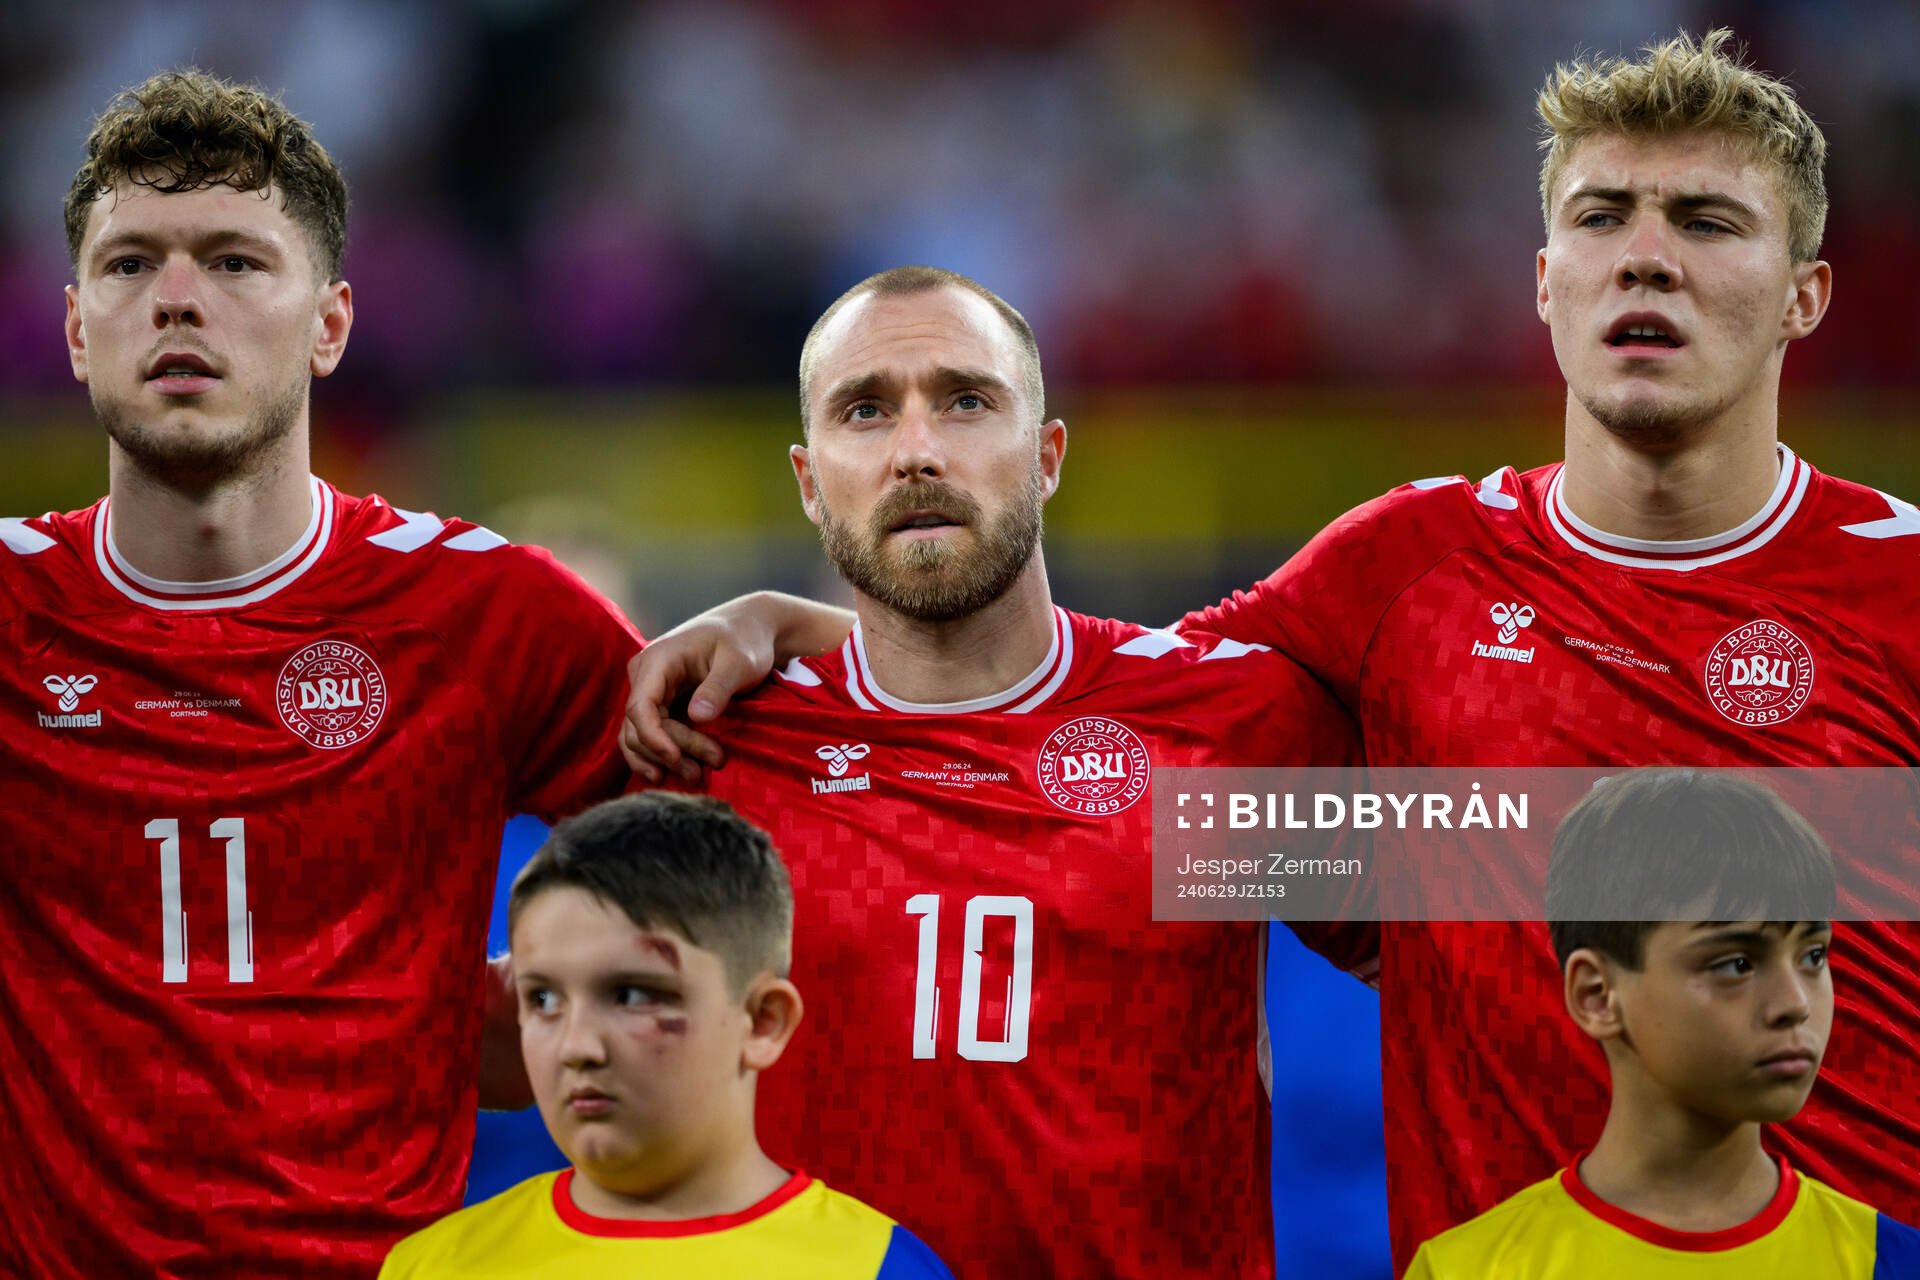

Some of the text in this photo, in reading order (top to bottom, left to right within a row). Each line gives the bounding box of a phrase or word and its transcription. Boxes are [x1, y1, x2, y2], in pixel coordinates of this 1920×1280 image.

[1471, 640, 1535, 664] hummel
[1564, 636, 1609, 653] GERMANY
[1624, 656, 1671, 674] DENMARK
[1596, 653, 1634, 668] DORTMUND
[1709, 649, 1732, 711] DANSK
[1727, 655, 1791, 688] DBU
[135, 698, 242, 710] GERMANY vs DENMARK
[280, 674, 310, 734] DANSK
[298, 677, 363, 710] DBU
[37, 709, 102, 728] hummel
[170, 710, 208, 718] DORTMUND
[1736, 709, 1779, 723] 1889
[314, 730, 358, 746] 1889
[901, 770, 949, 780] GERMANY
[964, 772, 1010, 782] DENMARK
[942, 762, 971, 770] 29.06.24
[1041, 749, 1071, 805] DANSK
[1061, 752, 1127, 782] DBU
[811, 772, 871, 795] hummel
[936, 781, 974, 789] DORTMUND
[1075, 799, 1120, 813] 1889
[144, 817, 254, 983] 11
[905, 894, 1034, 1062] 10
